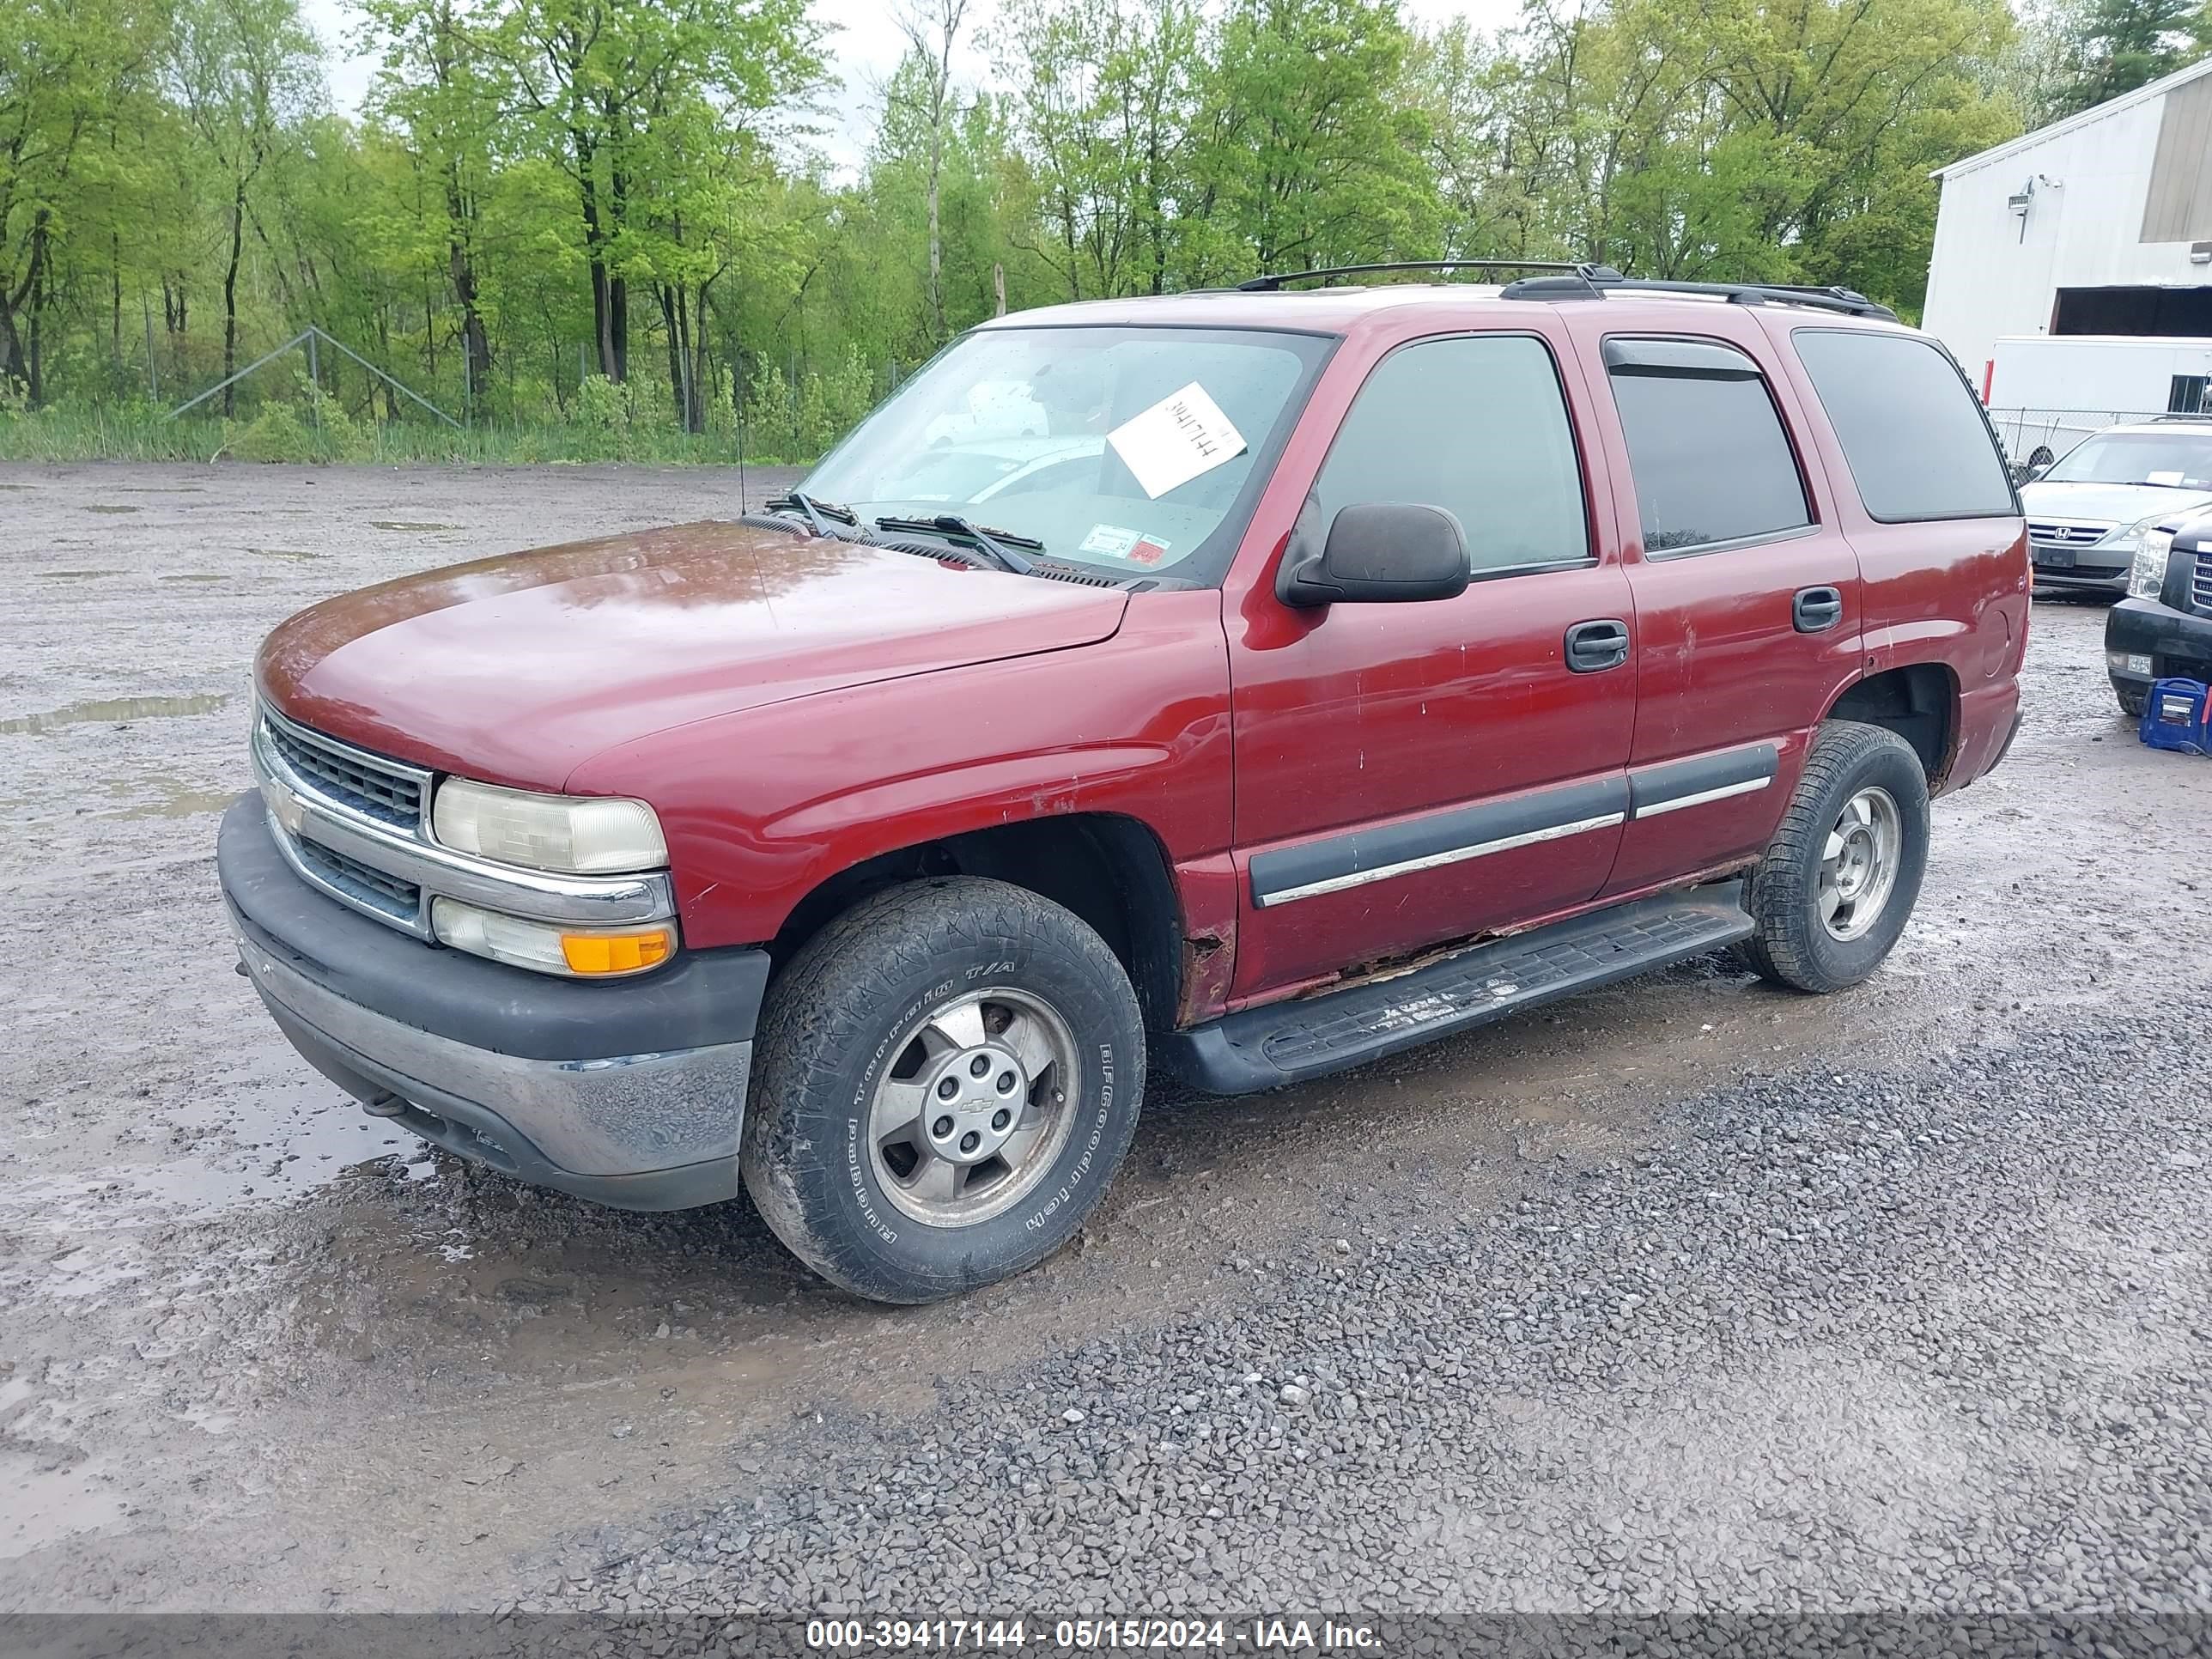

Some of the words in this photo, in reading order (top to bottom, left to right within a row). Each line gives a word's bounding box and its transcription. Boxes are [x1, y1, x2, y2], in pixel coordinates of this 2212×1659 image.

[964, 961, 1016, 980] T/A
[853, 978, 955, 1106] Terrain
[848, 1118, 898, 1245] Rugged
[1025, 1043, 1114, 1231] BFGoodrich
